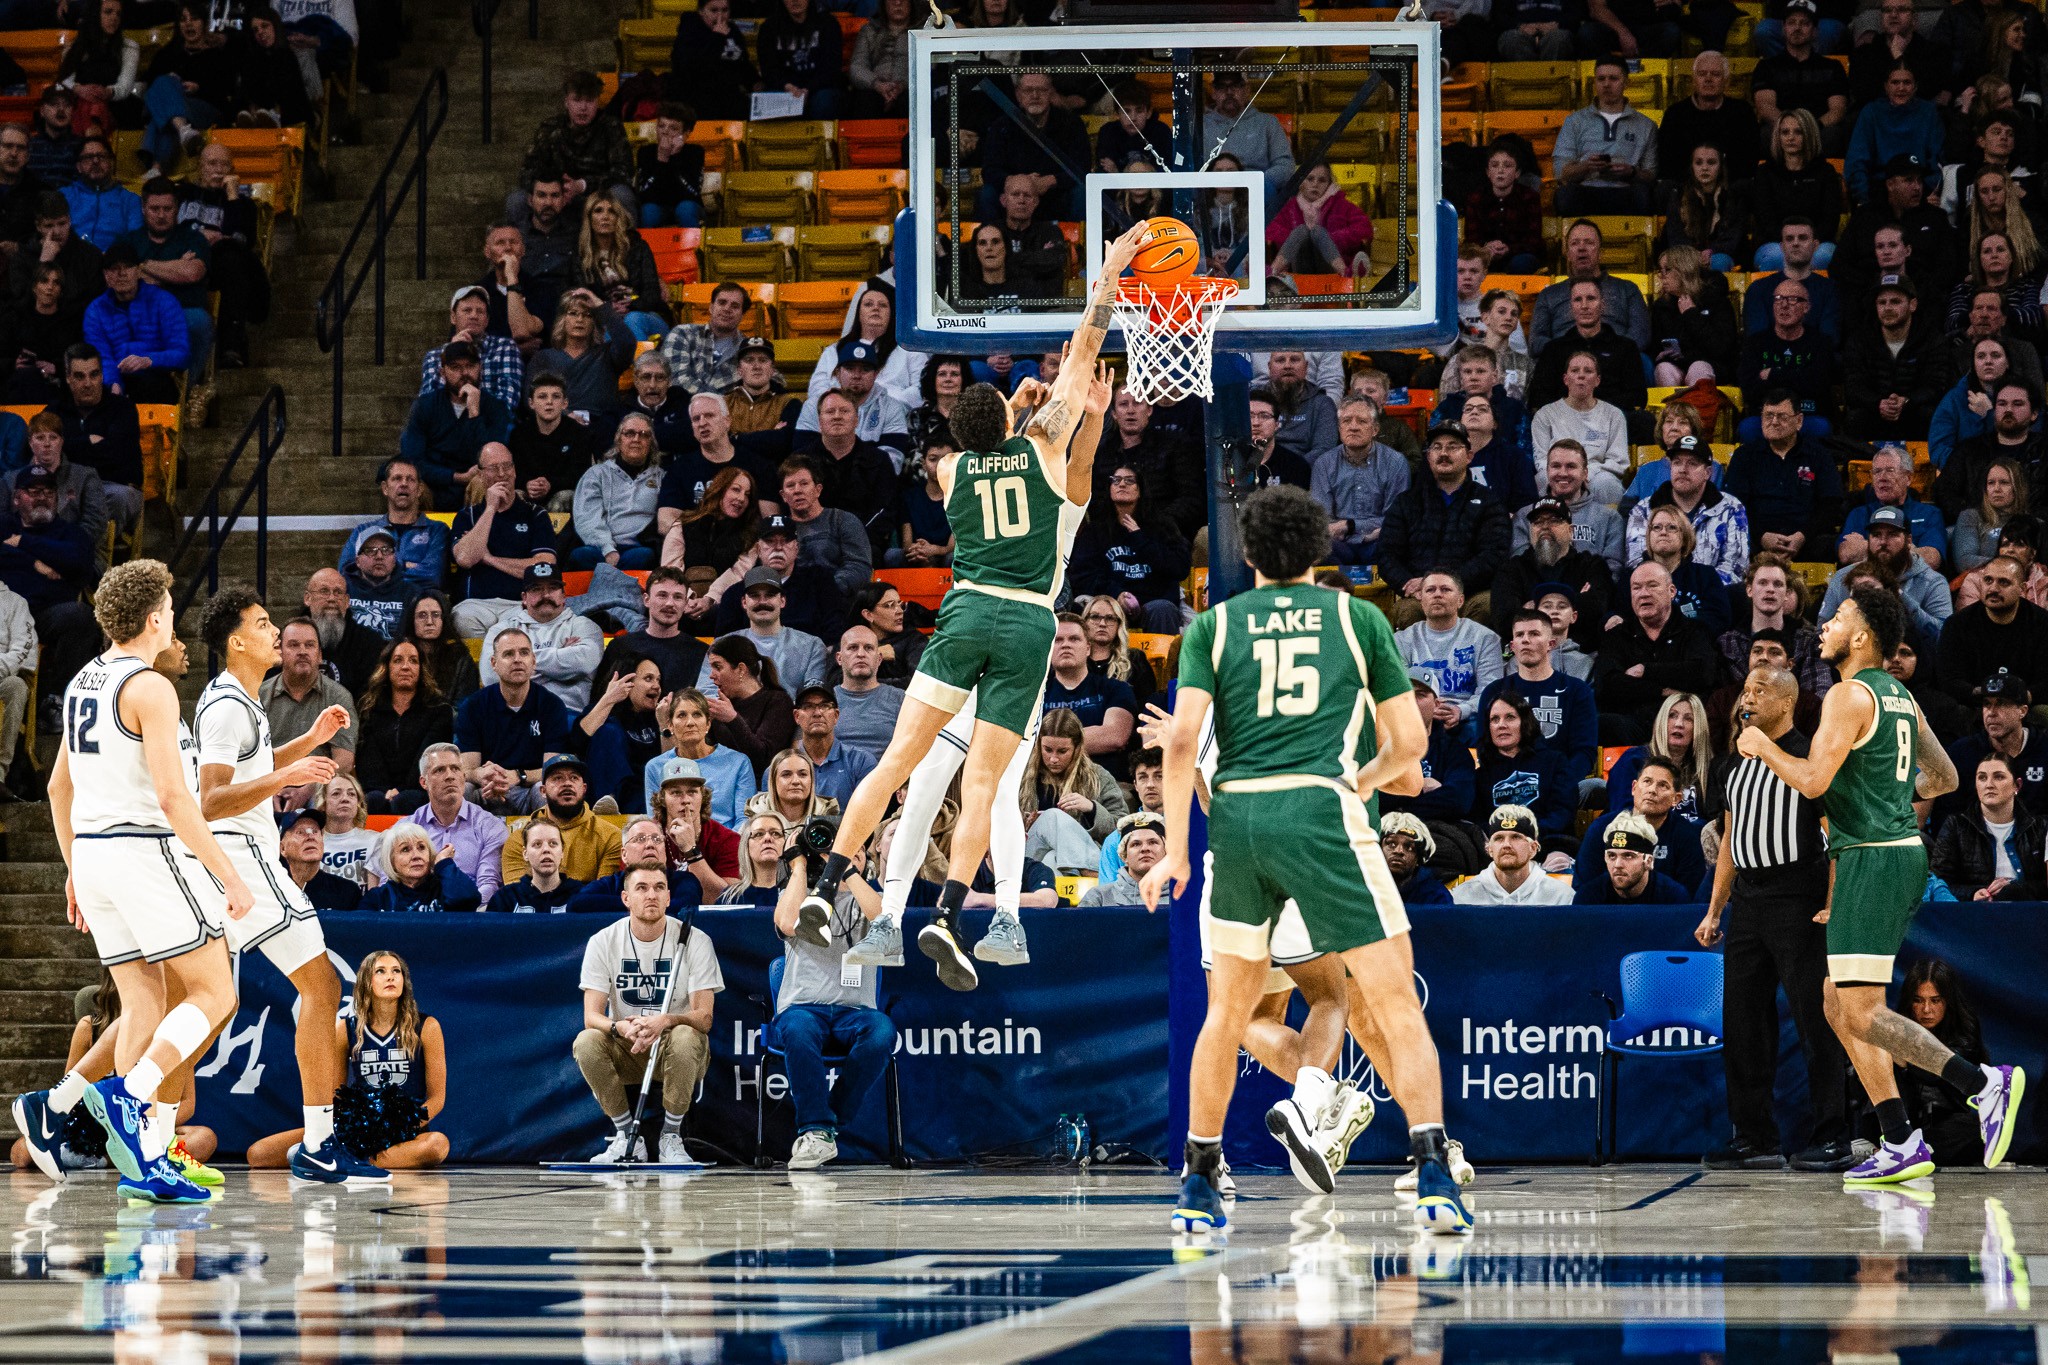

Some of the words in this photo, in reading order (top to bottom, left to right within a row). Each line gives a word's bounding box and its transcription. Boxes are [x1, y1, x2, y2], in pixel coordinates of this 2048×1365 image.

[1151, 227, 1178, 239] ELIT
[937, 317, 986, 330] SPALDING
[967, 452, 1028, 475] CLIFFORD
[973, 475, 1030, 540] 10
[772, 516, 785, 527] A
[1571, 525, 1596, 545] TATE
[373, 600, 404, 610] STATE
[1247, 608, 1322, 634] LAKE
[1141, 641, 1150, 651] 12
[1252, 636, 1321, 717] 15
[67, 695, 100, 754] 12
[1896, 718, 1911, 782] 8
[323, 848, 368, 868] GGIE
[1065, 884, 1074, 895] 12
[360, 1060, 411, 1077] STATE
[1462, 1063, 1597, 1100] Health
